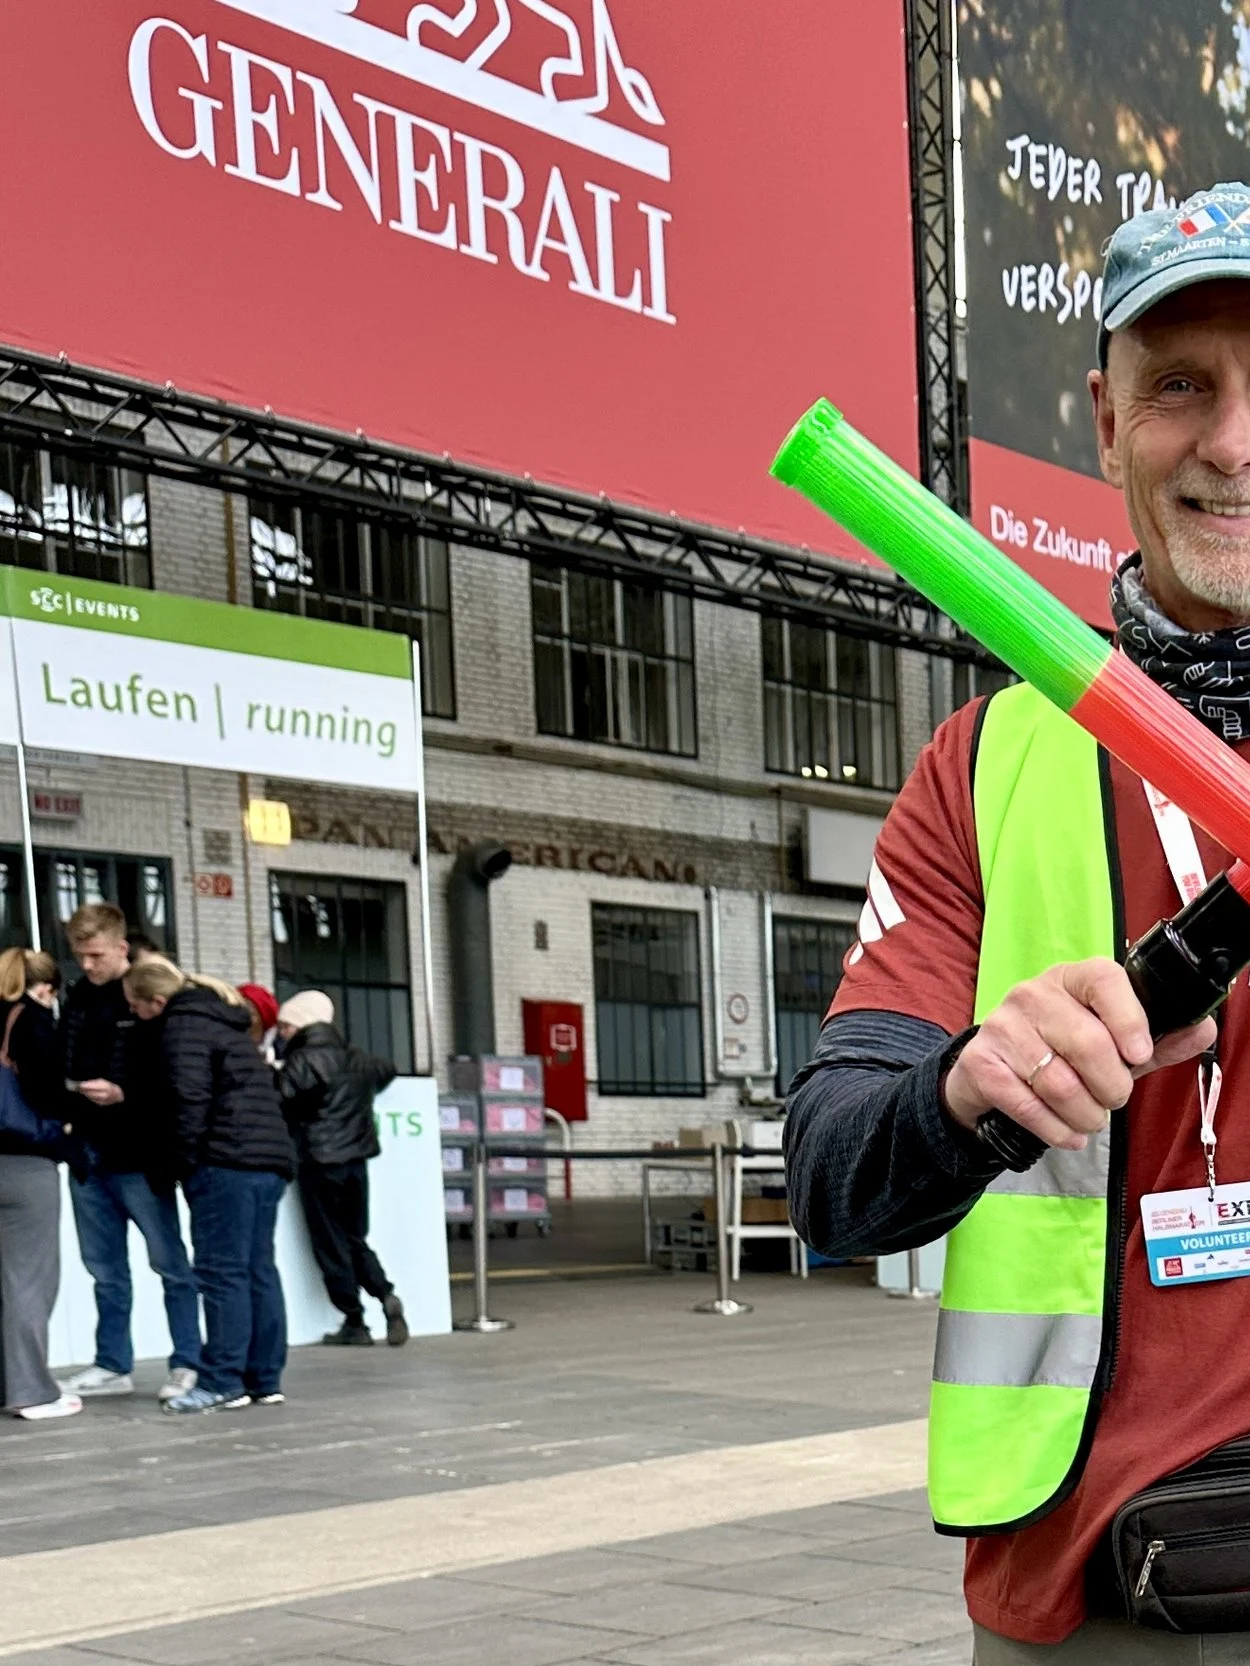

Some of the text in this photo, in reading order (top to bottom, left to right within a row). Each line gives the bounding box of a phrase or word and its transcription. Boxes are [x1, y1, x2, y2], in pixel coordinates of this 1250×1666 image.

[128, 17, 677, 325] GENERALI
[1005, 133, 1103, 206] JEDER
[990, 504, 1113, 573] Die Zukunft
[74, 597, 140, 622] EVENTS
[41, 662, 397, 758] Laufen running
